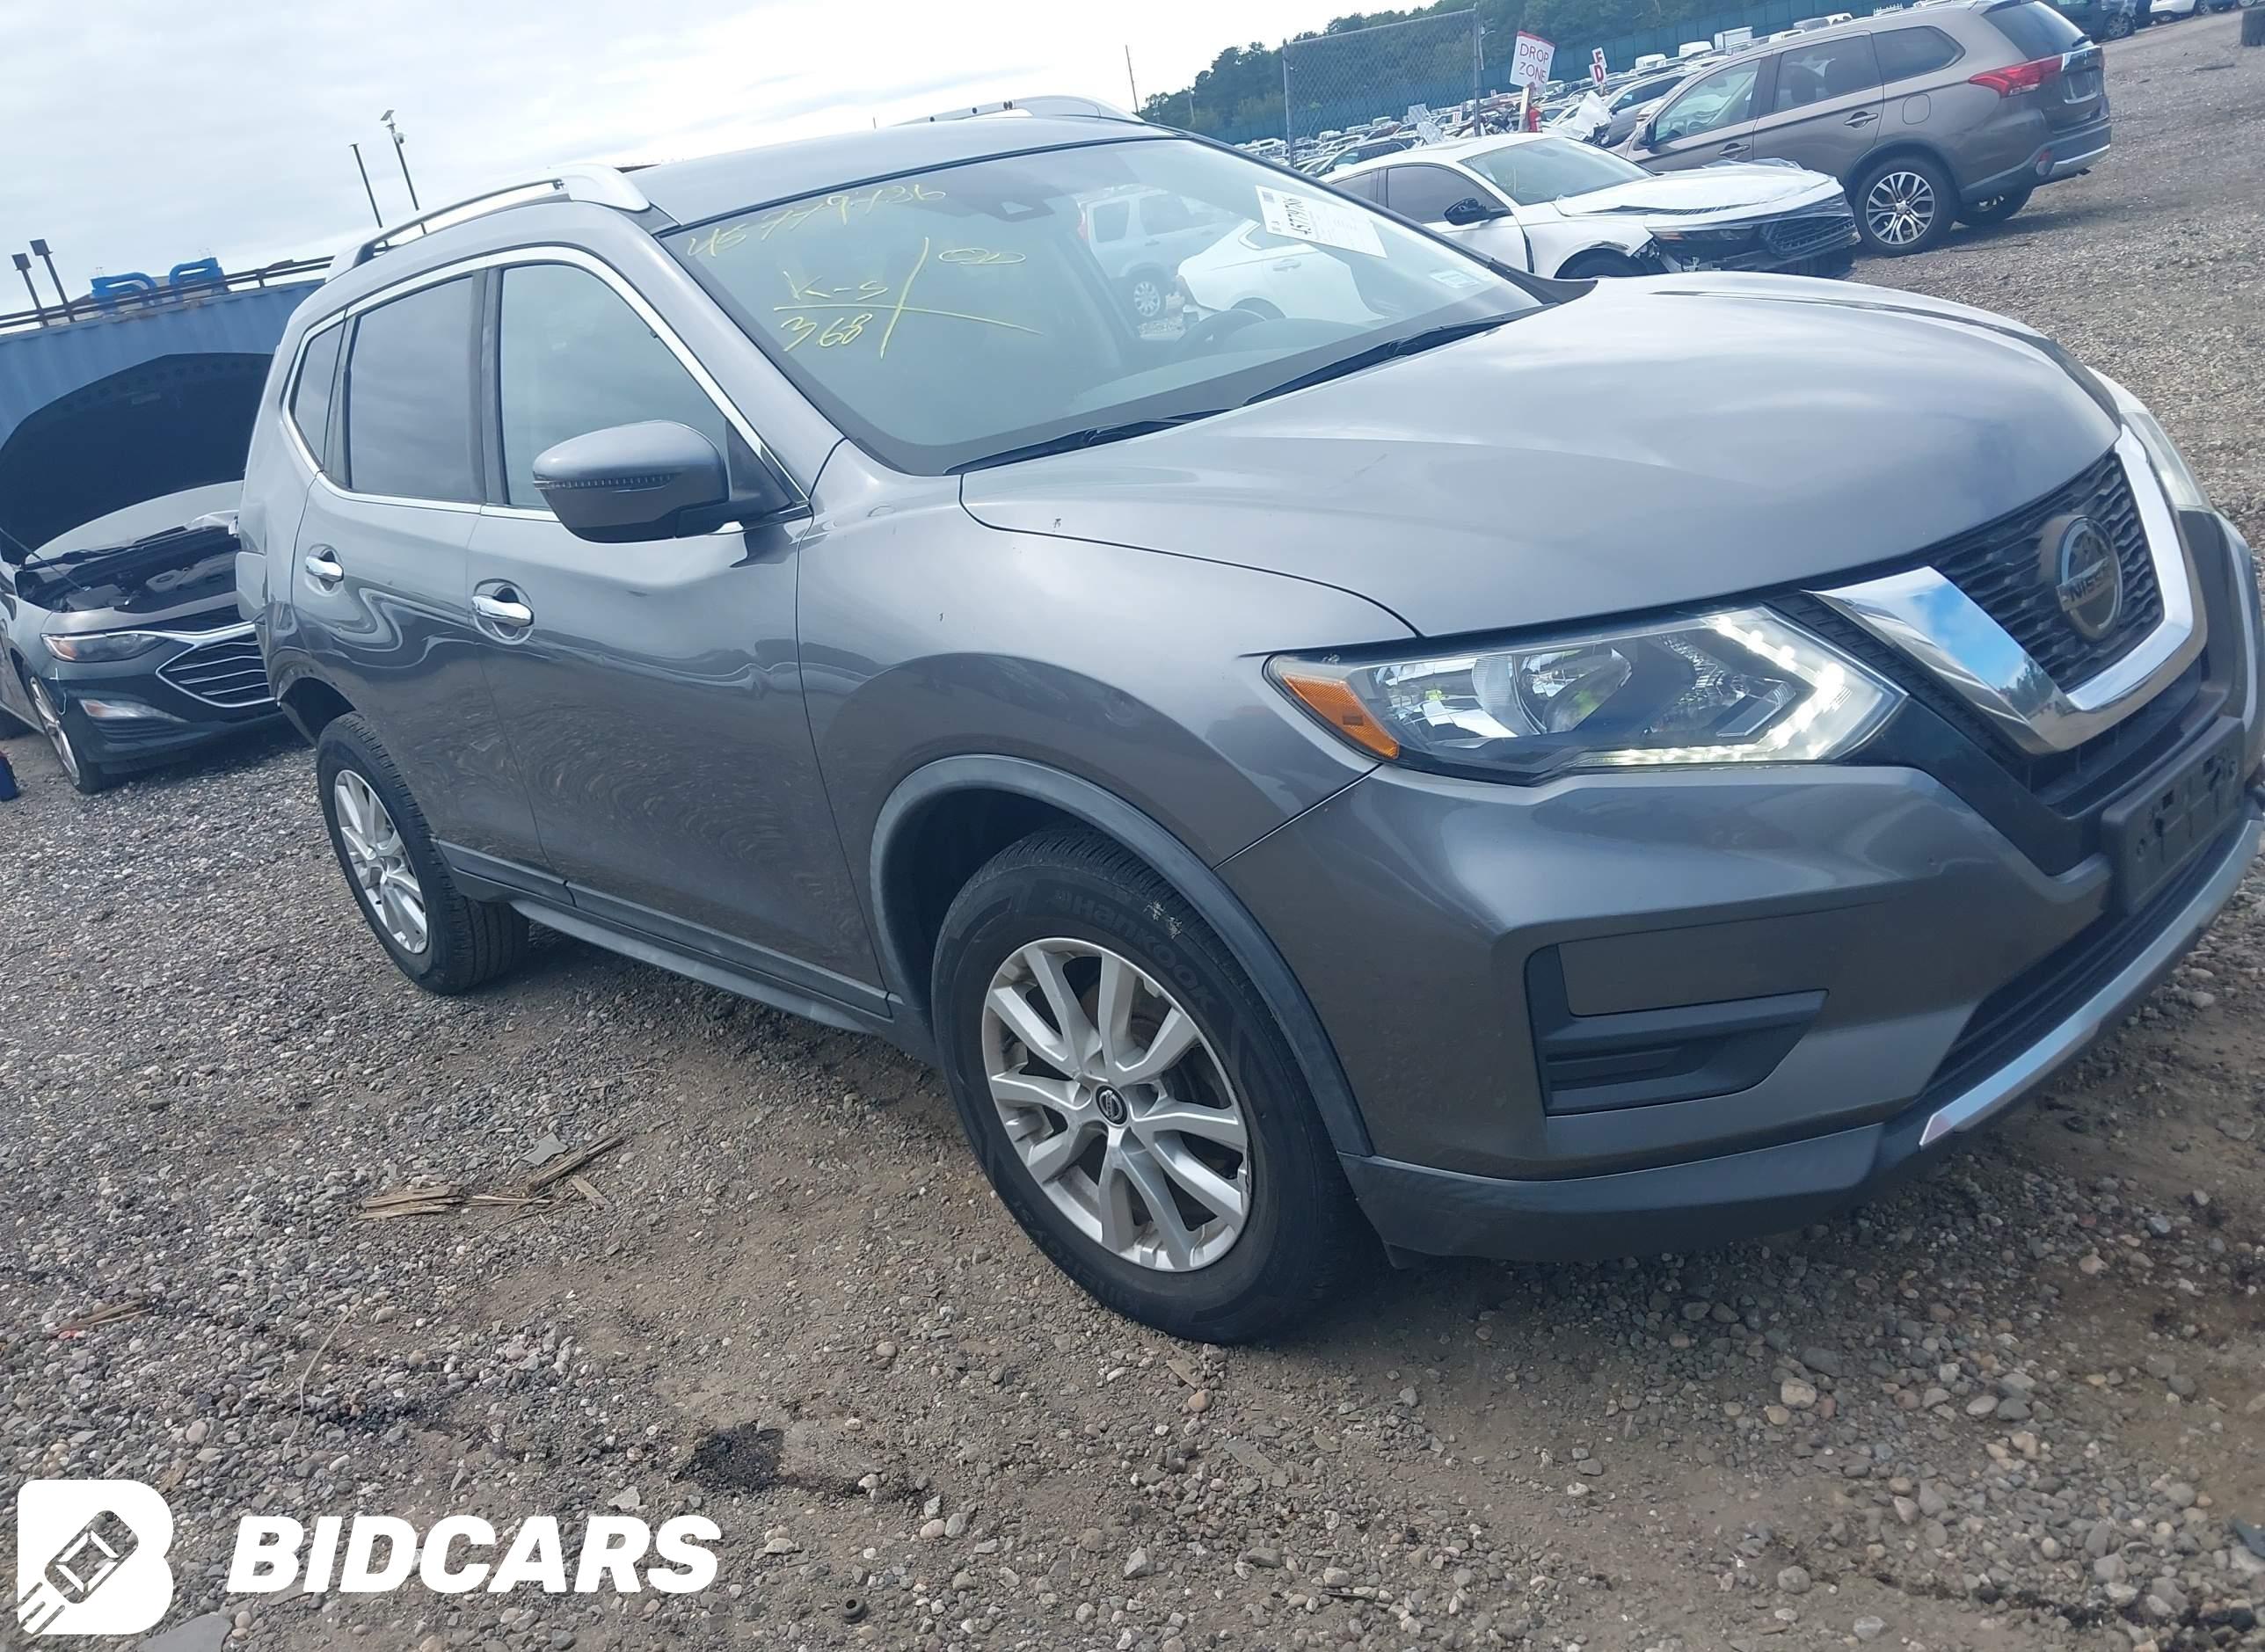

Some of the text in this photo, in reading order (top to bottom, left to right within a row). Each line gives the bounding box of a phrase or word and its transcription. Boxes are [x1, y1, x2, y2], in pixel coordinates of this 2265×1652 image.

[1519, 43, 1549, 64] DROP
[1519, 62, 1547, 84] ZONE
[1593, 64, 1605, 83] D
[781, 314, 872, 352] 368
[2069, 563, 2110, 603] NISS
